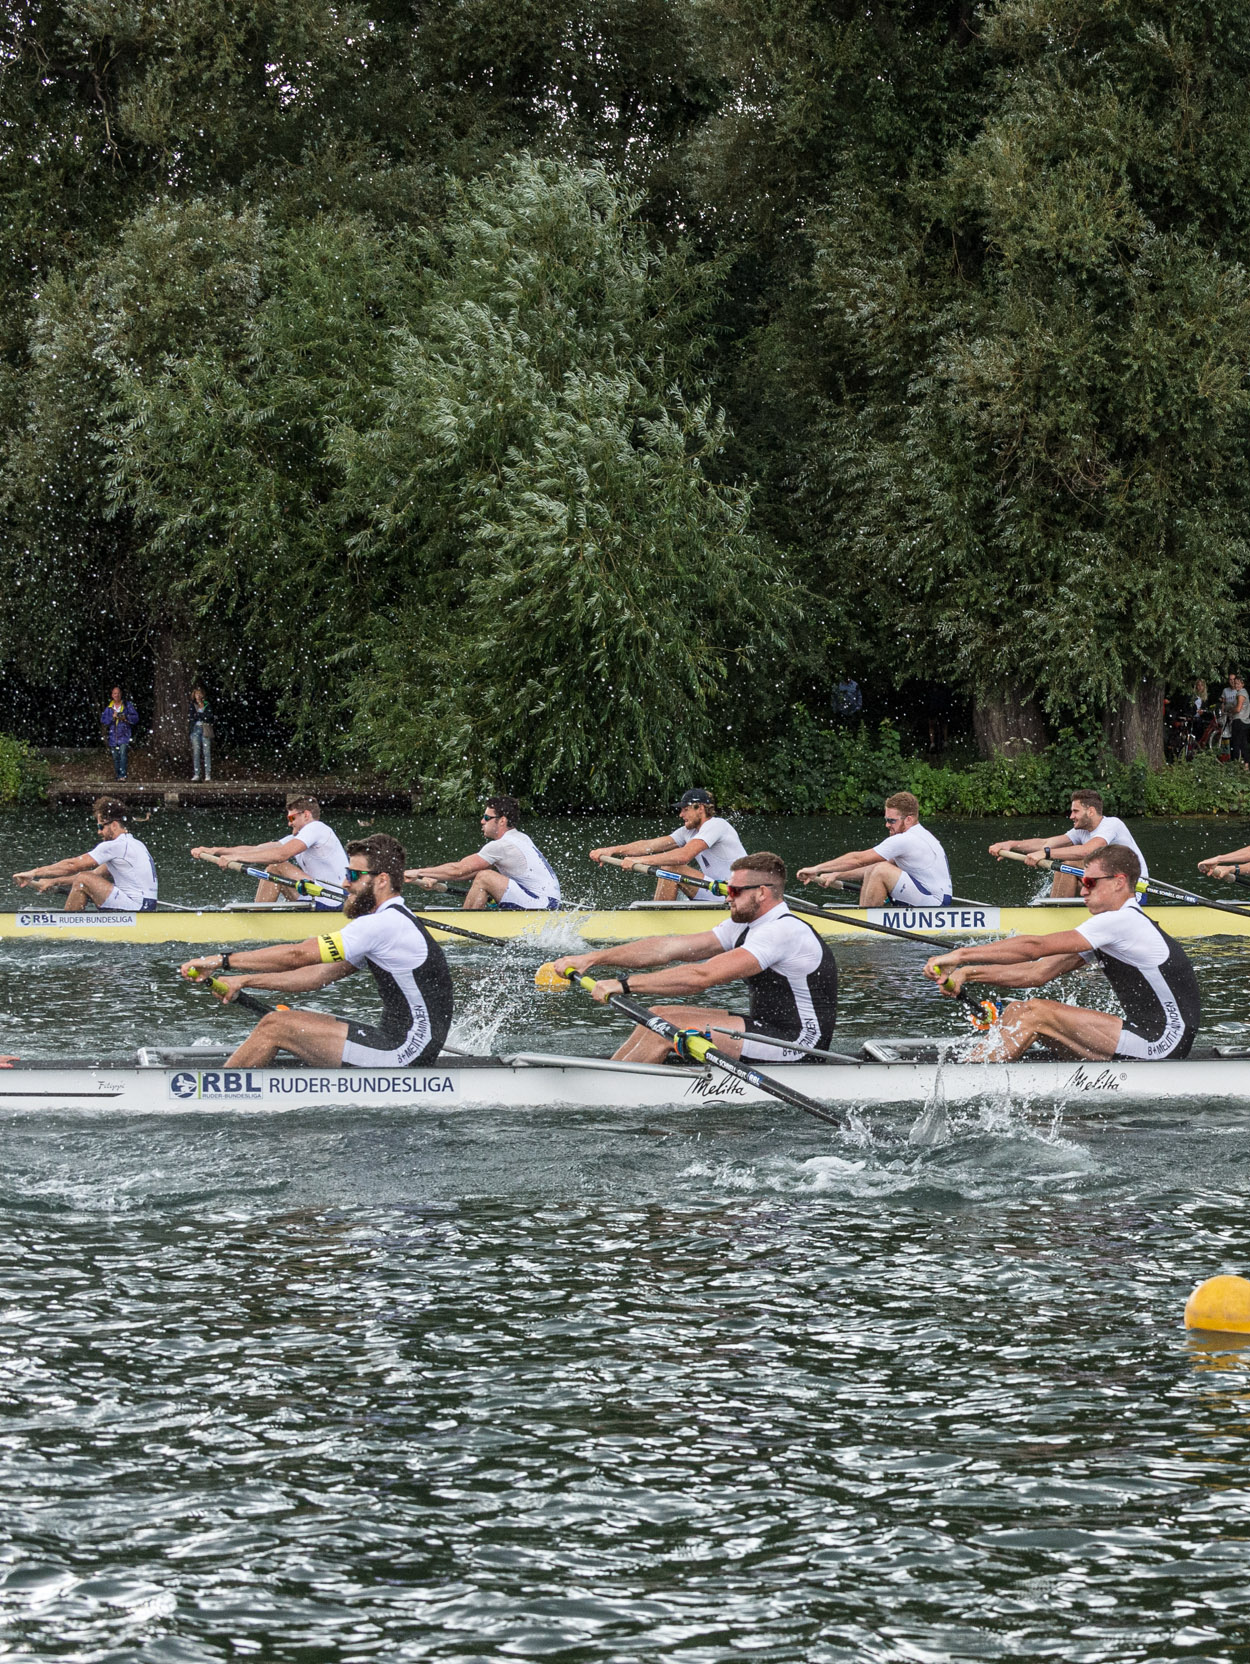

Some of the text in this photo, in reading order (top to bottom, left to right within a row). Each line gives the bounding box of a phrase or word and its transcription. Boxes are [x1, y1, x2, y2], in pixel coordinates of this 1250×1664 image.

[33, 914, 133, 924] RBL RUDER-BUNDESLIGA
[882, 908, 986, 929] MÜNSTER
[202, 1072, 455, 1094] RBL RUDER-BUNDESLIGA
